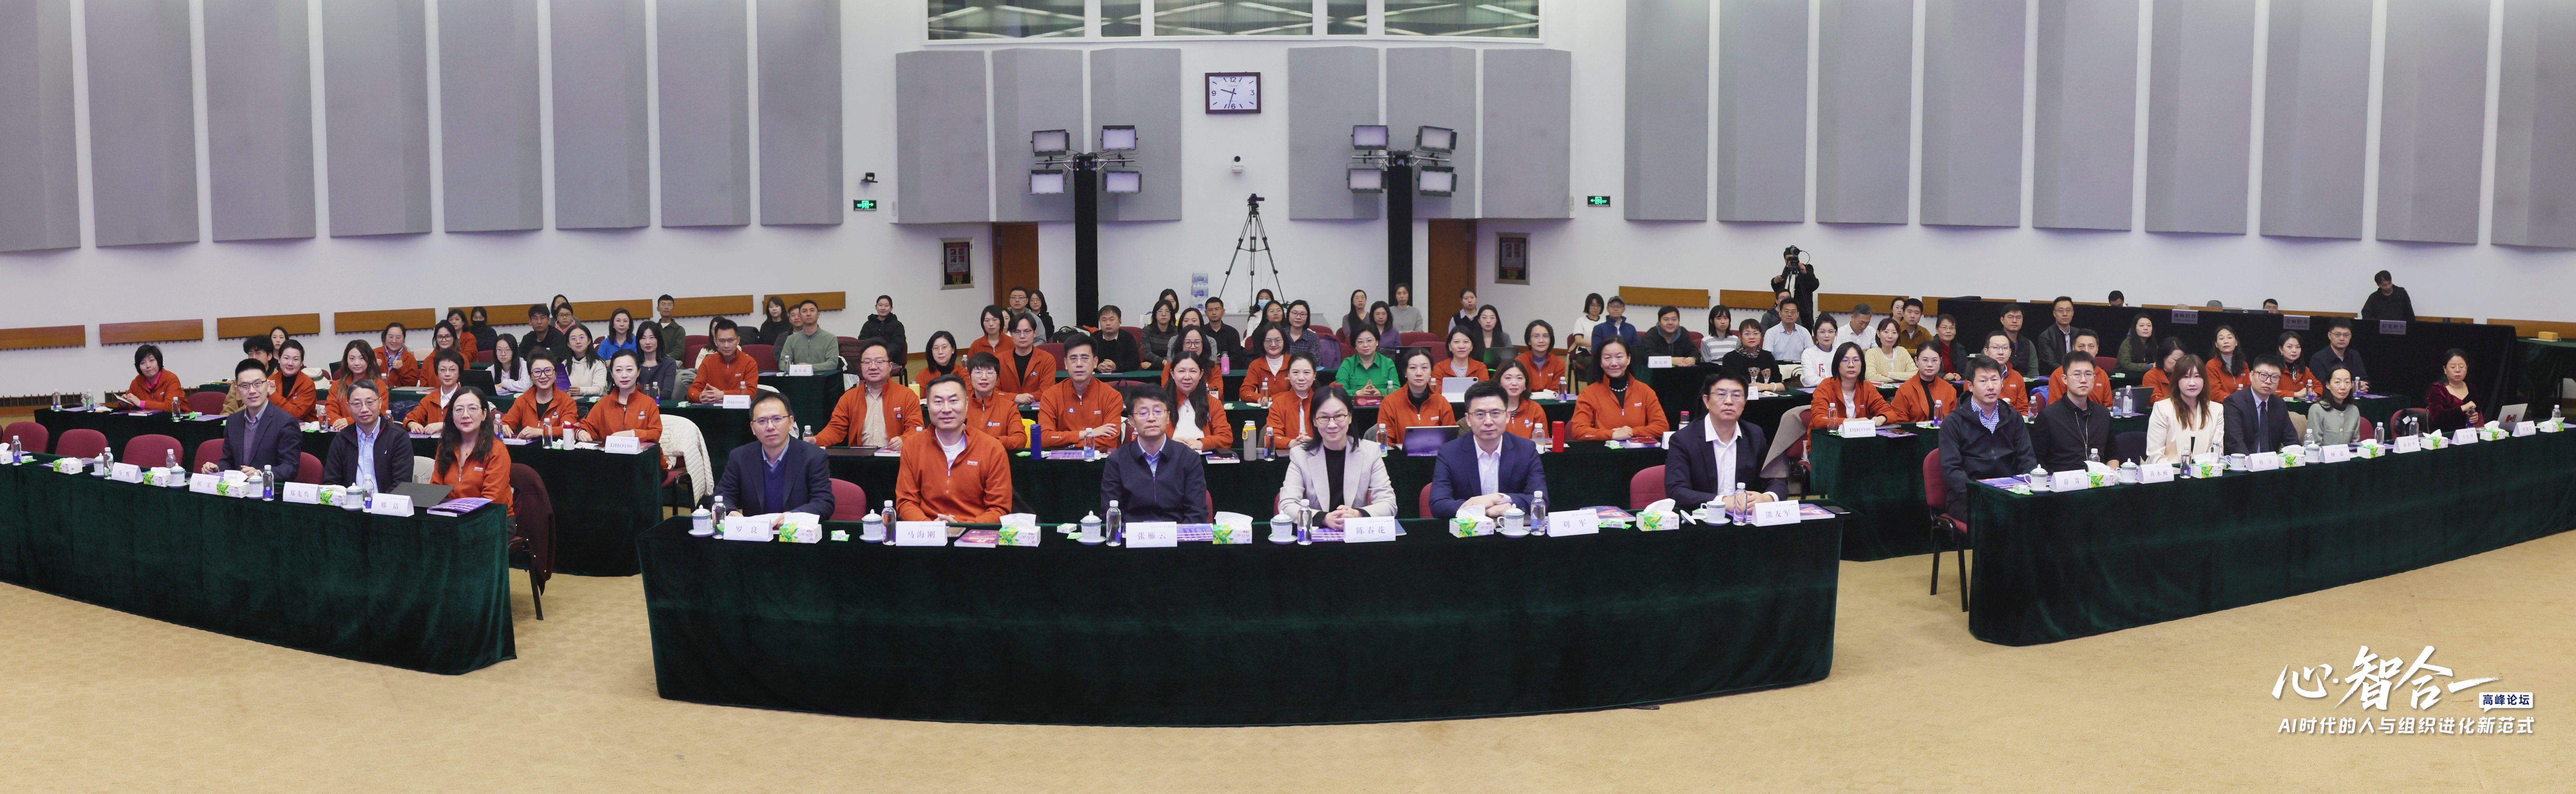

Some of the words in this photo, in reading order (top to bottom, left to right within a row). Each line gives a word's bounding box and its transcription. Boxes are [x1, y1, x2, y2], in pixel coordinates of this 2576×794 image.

[2064, 477, 2080, 486] 薛贵
[1765, 509, 1791, 519] 熊友军
[1563, 519, 1587, 528] 刘军
[908, 530, 935, 538] 马海刚
[1356, 526, 1385, 534] 陈春花
[1137, 532, 1167, 540] 张雁云
